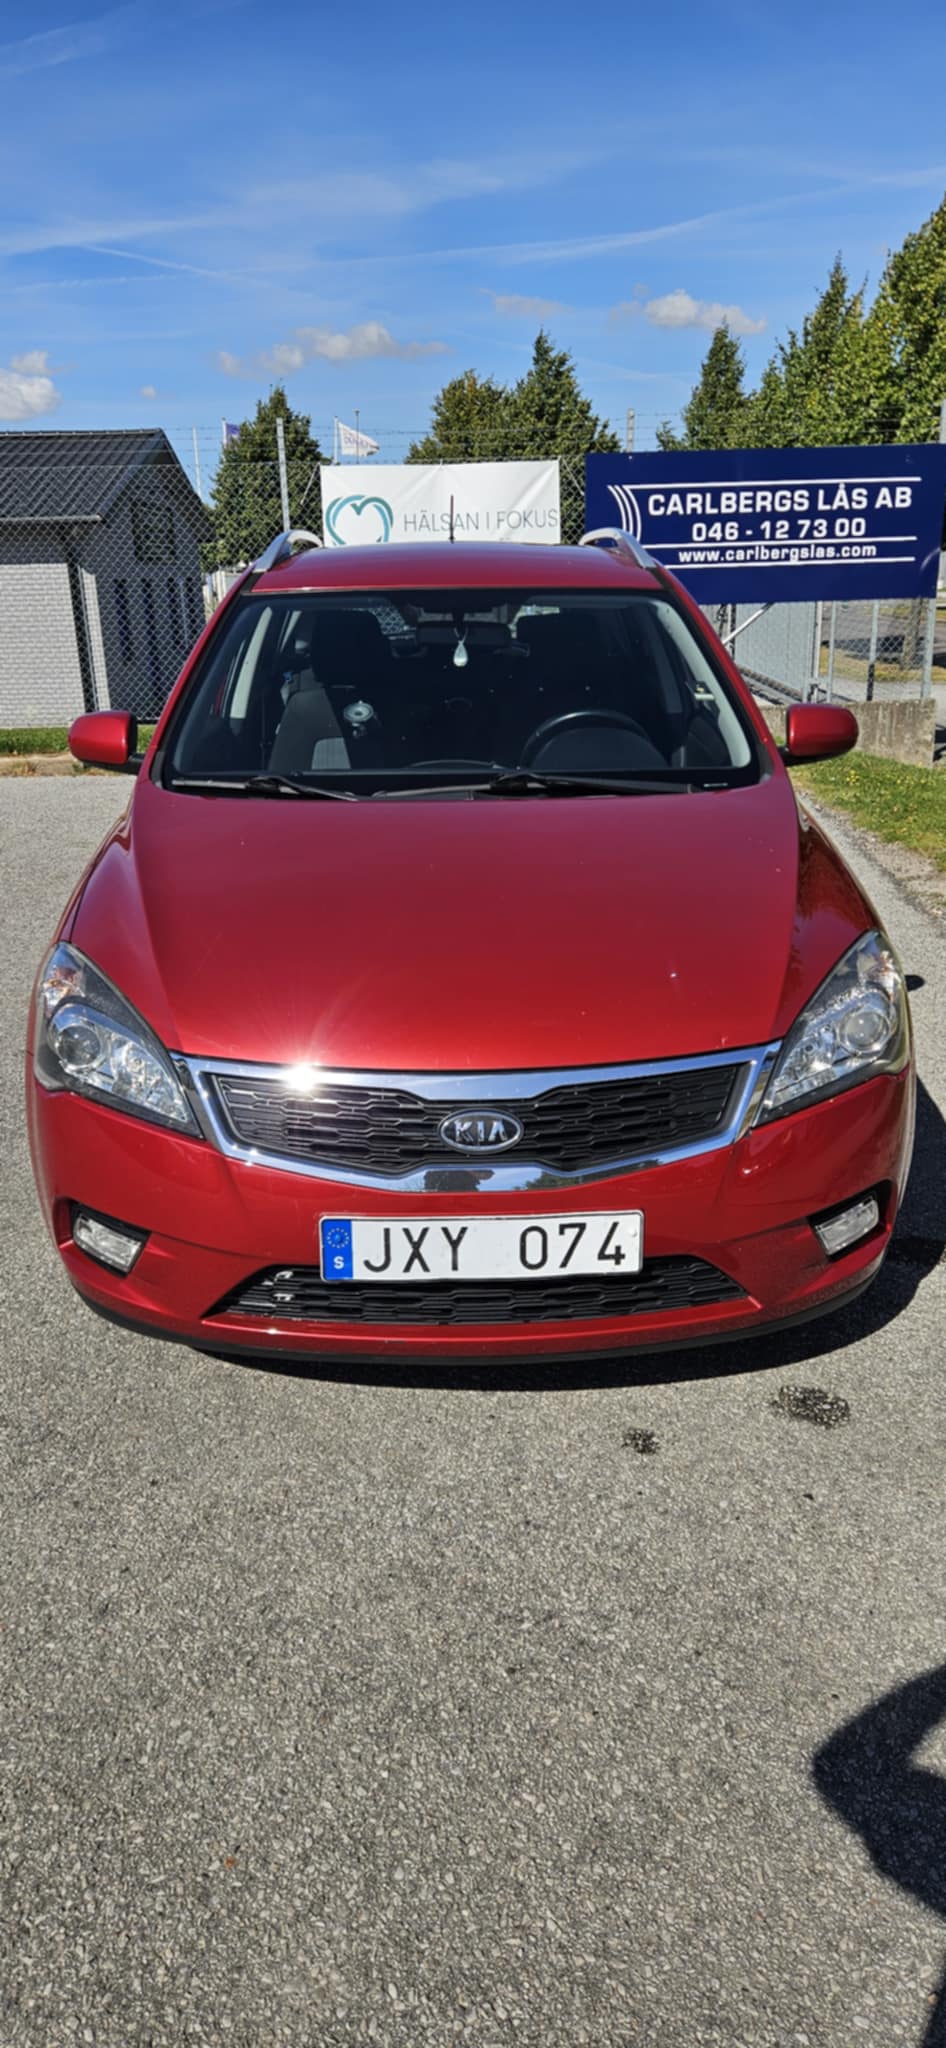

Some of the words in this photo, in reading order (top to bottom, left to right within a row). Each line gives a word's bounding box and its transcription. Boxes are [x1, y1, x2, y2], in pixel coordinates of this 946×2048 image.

[648, 493, 809, 516] CARLBERGS
[817, 482, 868, 511] LÅS
[874, 486, 913, 509] AB
[403, 509, 480, 532] HÄLSAN
[496, 508, 558, 530] FOKUS
[692, 522, 739, 541] 046
[760, 520, 790, 539] 12
[797, 519, 828, 539] 73
[834, 517, 866, 537] 00
[678, 545, 877, 563] www.carlbergslas.com
[454, 1120, 508, 1142] KIA
[363, 1226, 469, 1273] JXY
[519, 1222, 626, 1271] 074
[333, 1256, 345, 1269] S
